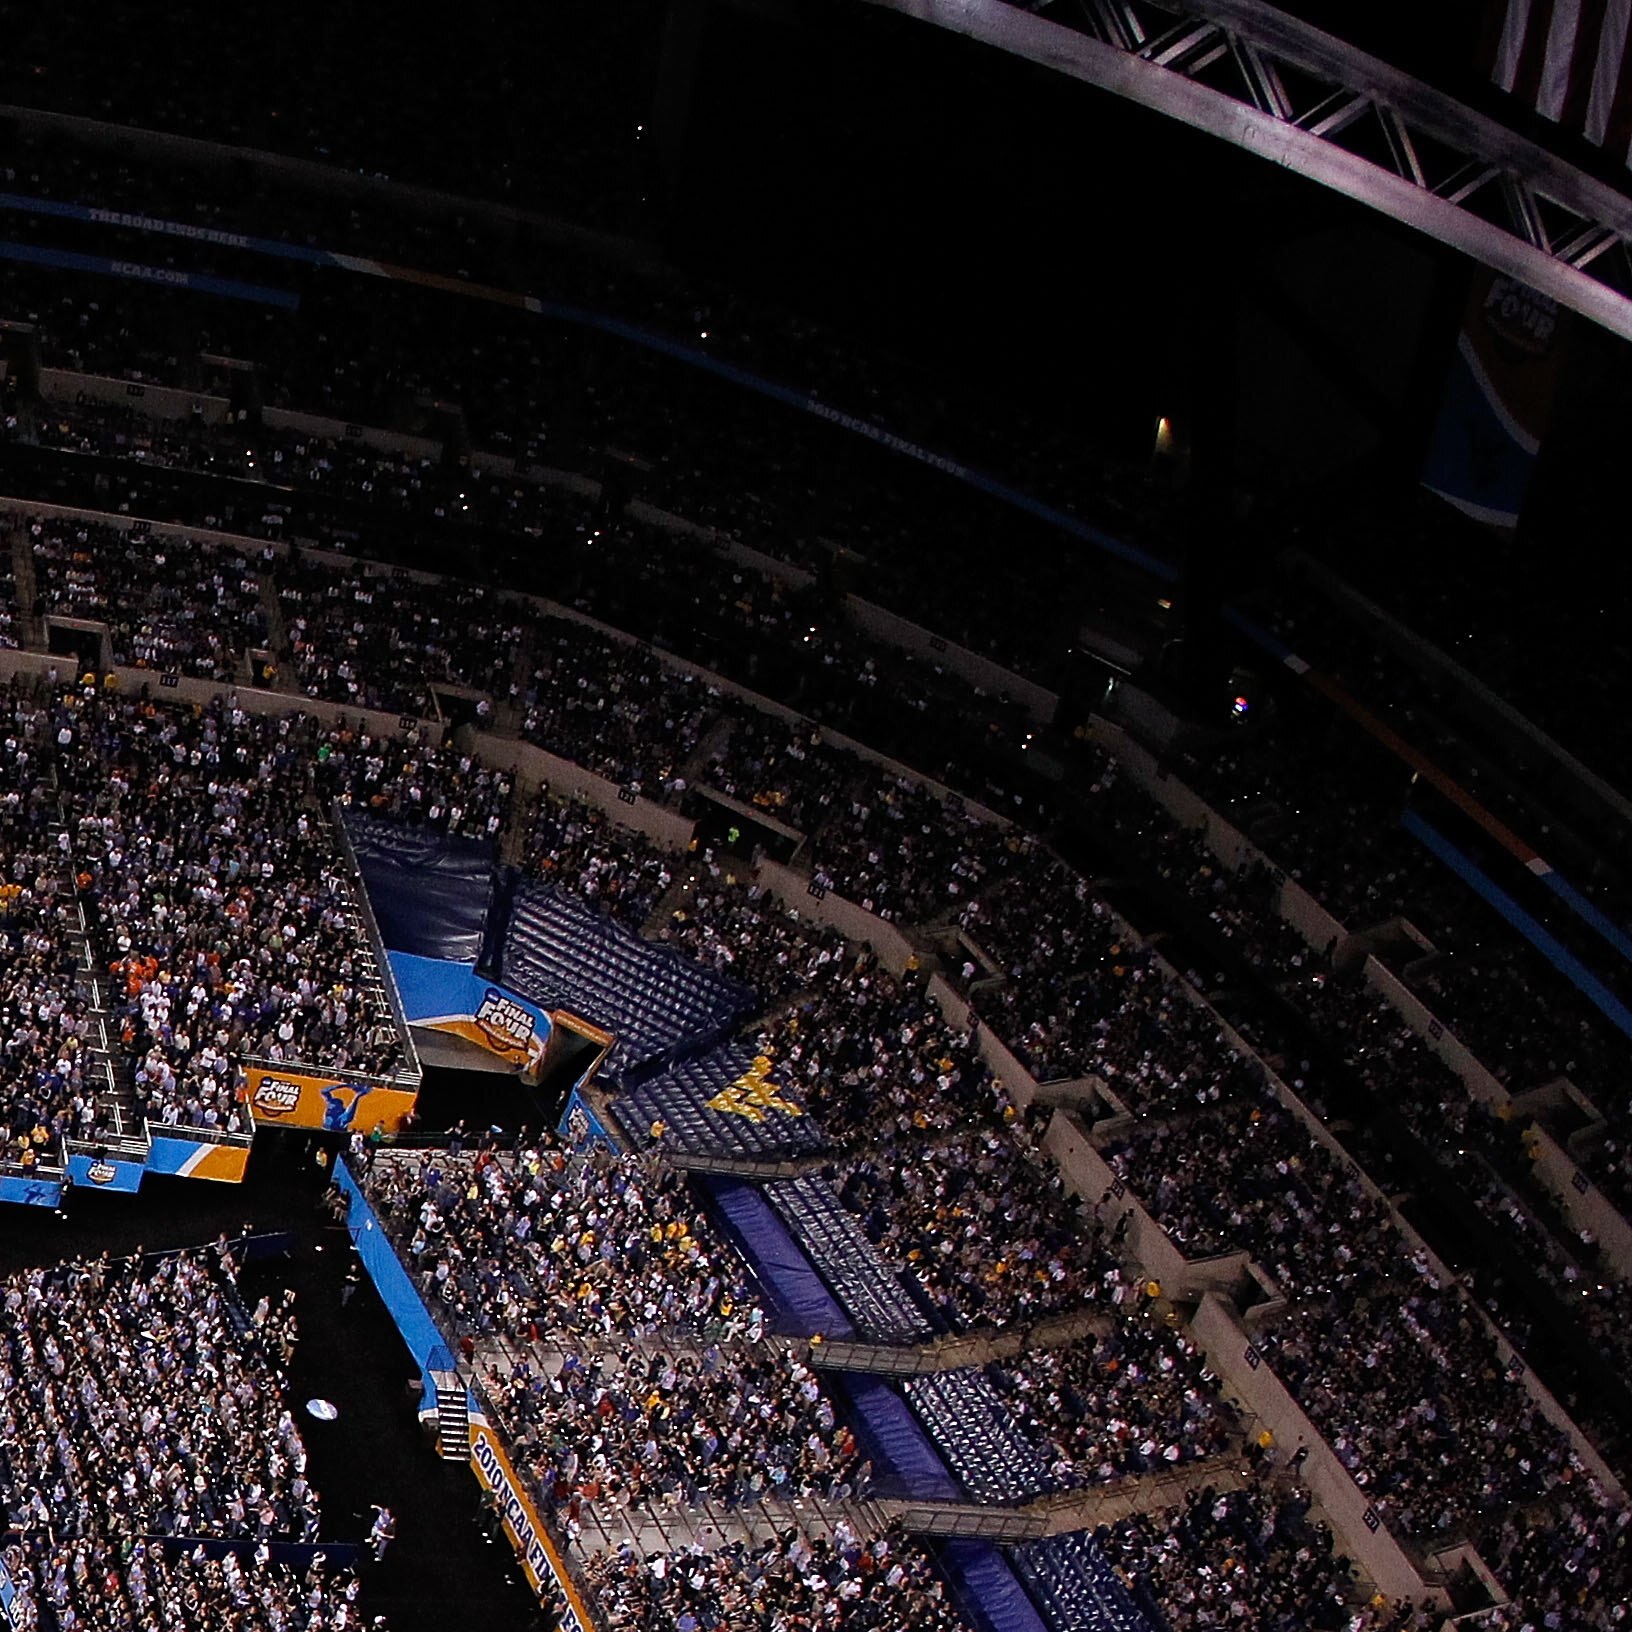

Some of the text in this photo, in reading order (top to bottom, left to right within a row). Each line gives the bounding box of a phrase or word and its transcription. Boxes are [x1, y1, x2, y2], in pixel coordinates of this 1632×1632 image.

[476, 999, 532, 1043] FOUR
[496, 996, 534, 1027] FINAL
[255, 1089, 298, 1106] FOUR
[270, 1080, 301, 1094] FINAL
[473, 1432, 506, 1494] 2010
[500, 1478, 536, 1559] NCAA
